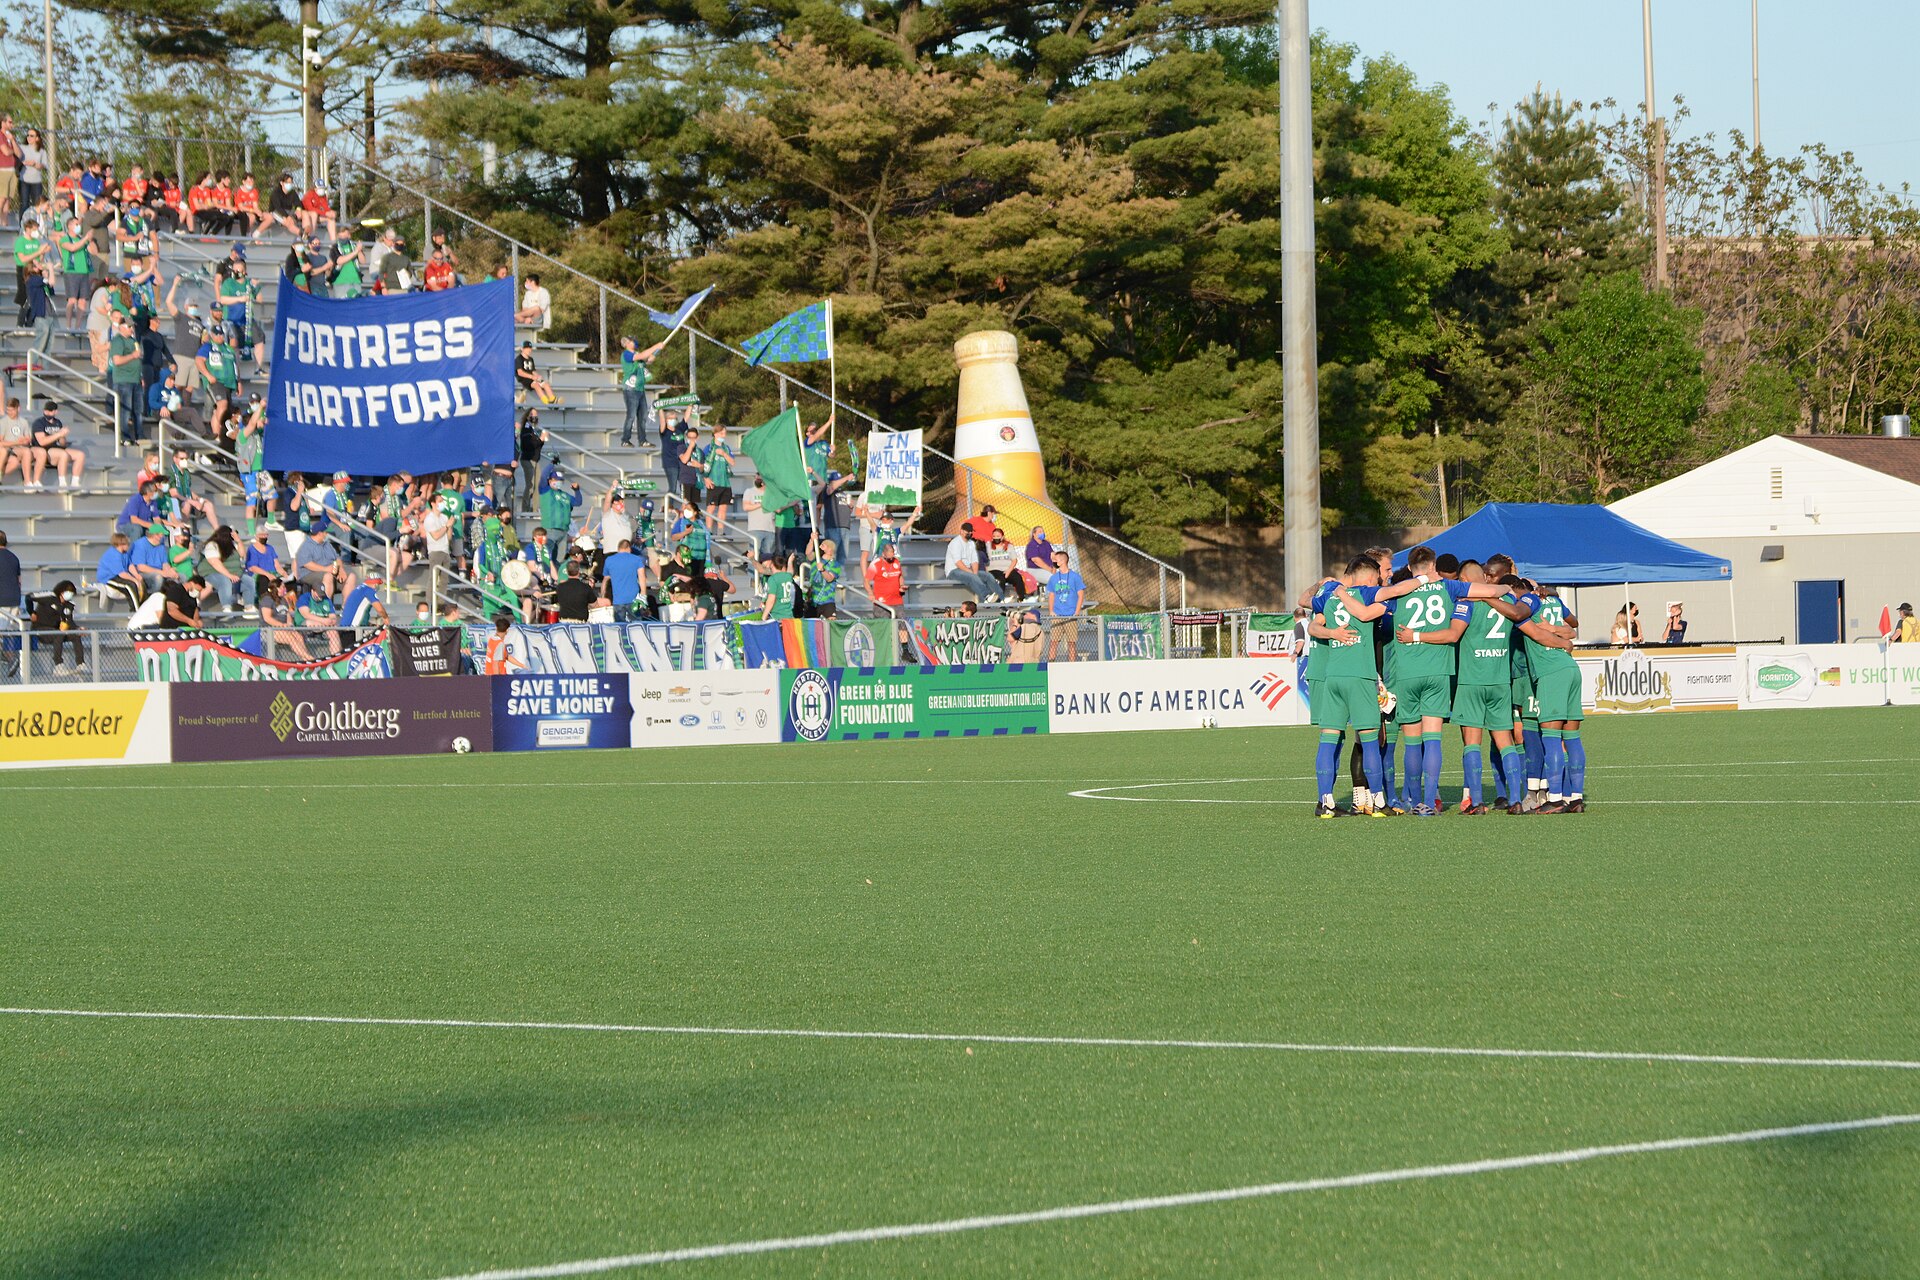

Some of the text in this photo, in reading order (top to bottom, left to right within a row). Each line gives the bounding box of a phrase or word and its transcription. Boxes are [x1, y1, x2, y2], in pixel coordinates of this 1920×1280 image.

[284, 316, 473, 369] FORTRESS
[284, 376, 480, 428] HARTFORD
[884, 432, 909, 450] IN
[868, 450, 920, 467] WATLING
[868, 464, 920, 480] WE TRUST
[781, 581, 792, 600] 19
[1334, 602, 1351, 626] 6
[1405, 594, 1446, 629] 28
[1486, 607, 1506, 638] 2
[936, 619, 999, 646] MAD HAT
[411, 645, 440, 658] LIVES
[1108, 633, 1156, 660] DEAD
[792, 672, 829, 695] HARTFORD
[1604, 659, 1662, 696] Modelo
[1687, 674, 1732, 684] FIGHTING SPIRIT
[1760, 673, 1794, 682] HORNITOS
[1861, 667, 1898, 684] SHOT
[510, 679, 599, 697] SAVE TIME
[641, 688, 662, 700] Jeep
[840, 684, 913, 700] GREEN BLUE
[507, 697, 614, 715] SAVE MONEY
[928, 692, 1046, 709] GREENANDBLUEFOUNDATION.ORG
[1055, 688, 1245, 715] BANK OF AMERICA
[0, 708, 123, 738] ck&Decker
[178, 714, 259, 726] Proud Supporter of
[294, 701, 400, 738] Goldberg
[413, 709, 481, 720] Hartford Athletic
[841, 703, 914, 725] FOUNDATION
[296, 731, 386, 742] CAPITAL MANAGEMENT
[542, 727, 585, 736] GENGRAS
[795, 719, 829, 738] ATHLETIC
